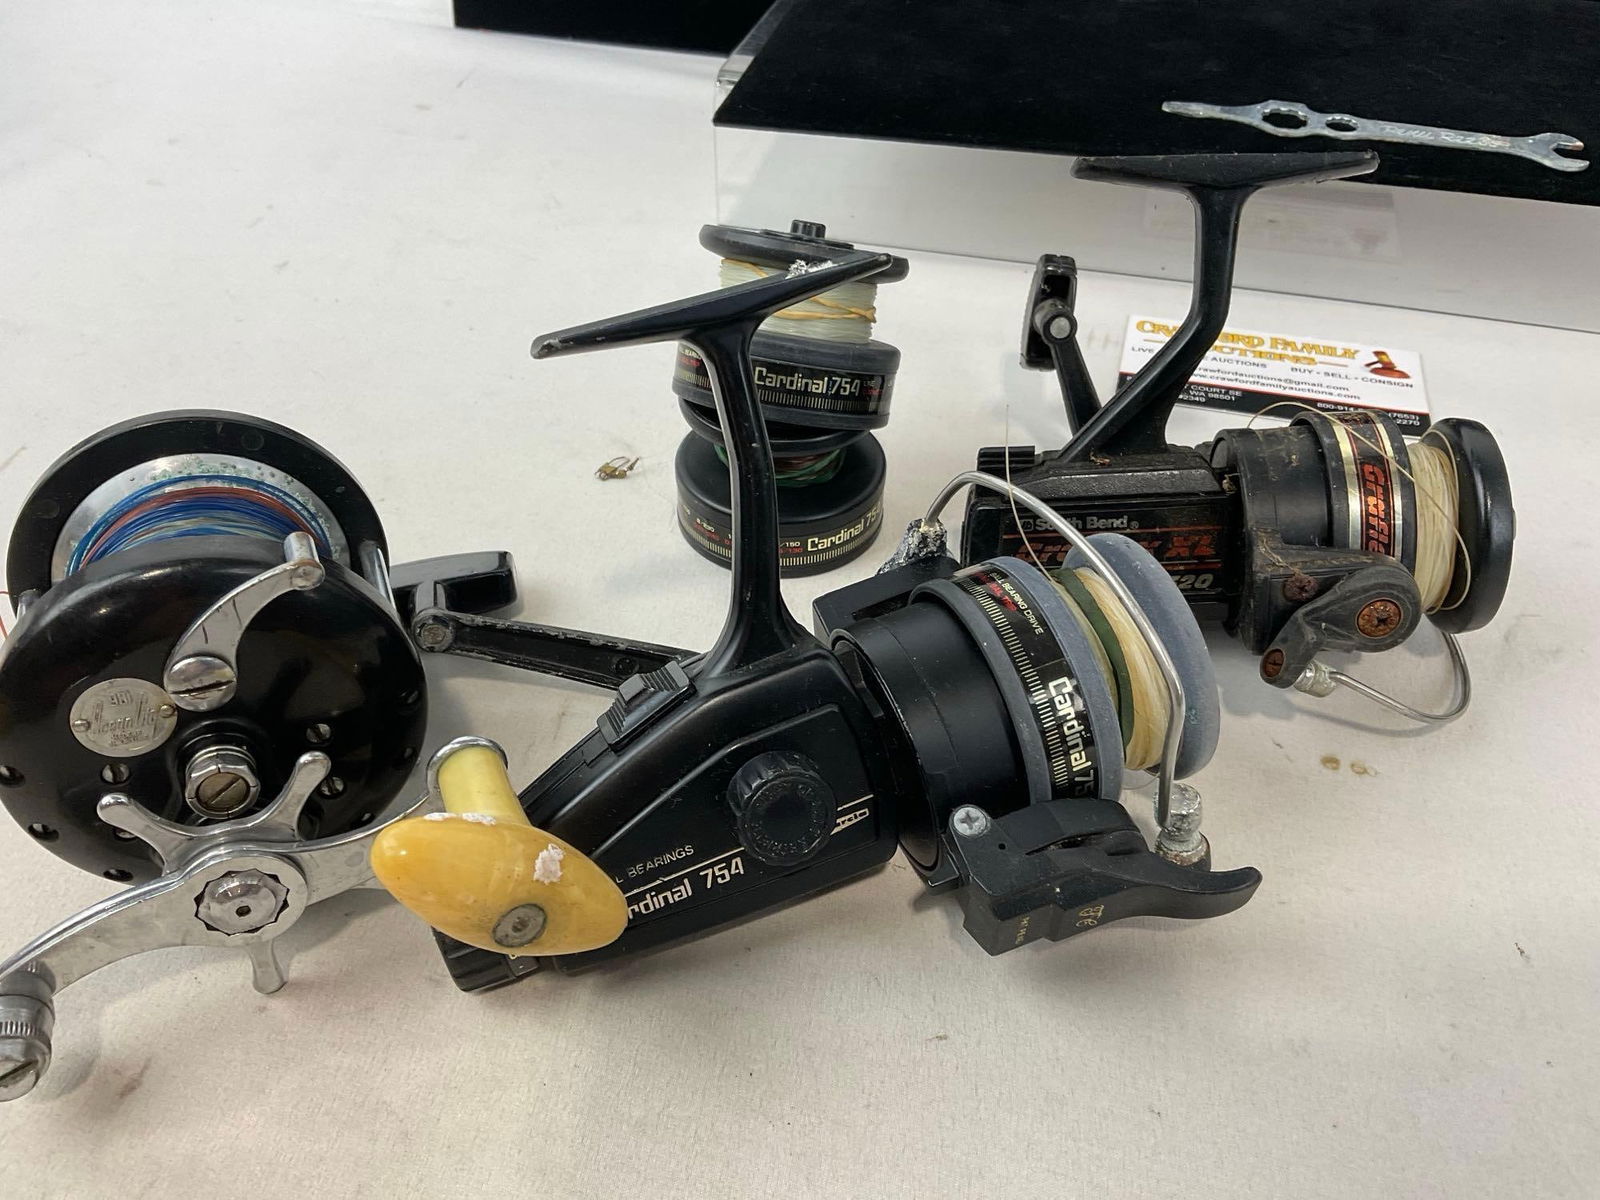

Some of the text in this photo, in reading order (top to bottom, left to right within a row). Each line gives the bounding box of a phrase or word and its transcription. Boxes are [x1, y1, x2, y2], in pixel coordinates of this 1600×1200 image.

[1212, 345, 1317, 366] CTIONS
[1270, 336, 1361, 360] FAMILY
[754, 366, 829, 394] Cardinal
[831, 375, 862, 396] 754
[1198, 366, 1350, 392] rawfordauctions@gmail.com
[1210, 356, 1267, 369] AUCTIONS
[1361, 376, 1414, 388] CONSIGN
[1189, 389, 1206, 398] WA
[1190, 384, 1226, 395] COURT
[807, 518, 864, 551] Cardinal
[1035, 515, 1128, 531] Soh Bend
[1001, 581, 1029, 611] BEARING
[1023, 608, 1044, 636] DRIVE
[1048, 676, 1095, 797] Cardinal 75
[628, 845, 694, 877] BEARINGS
[627, 856, 745, 920] rdinal 754
